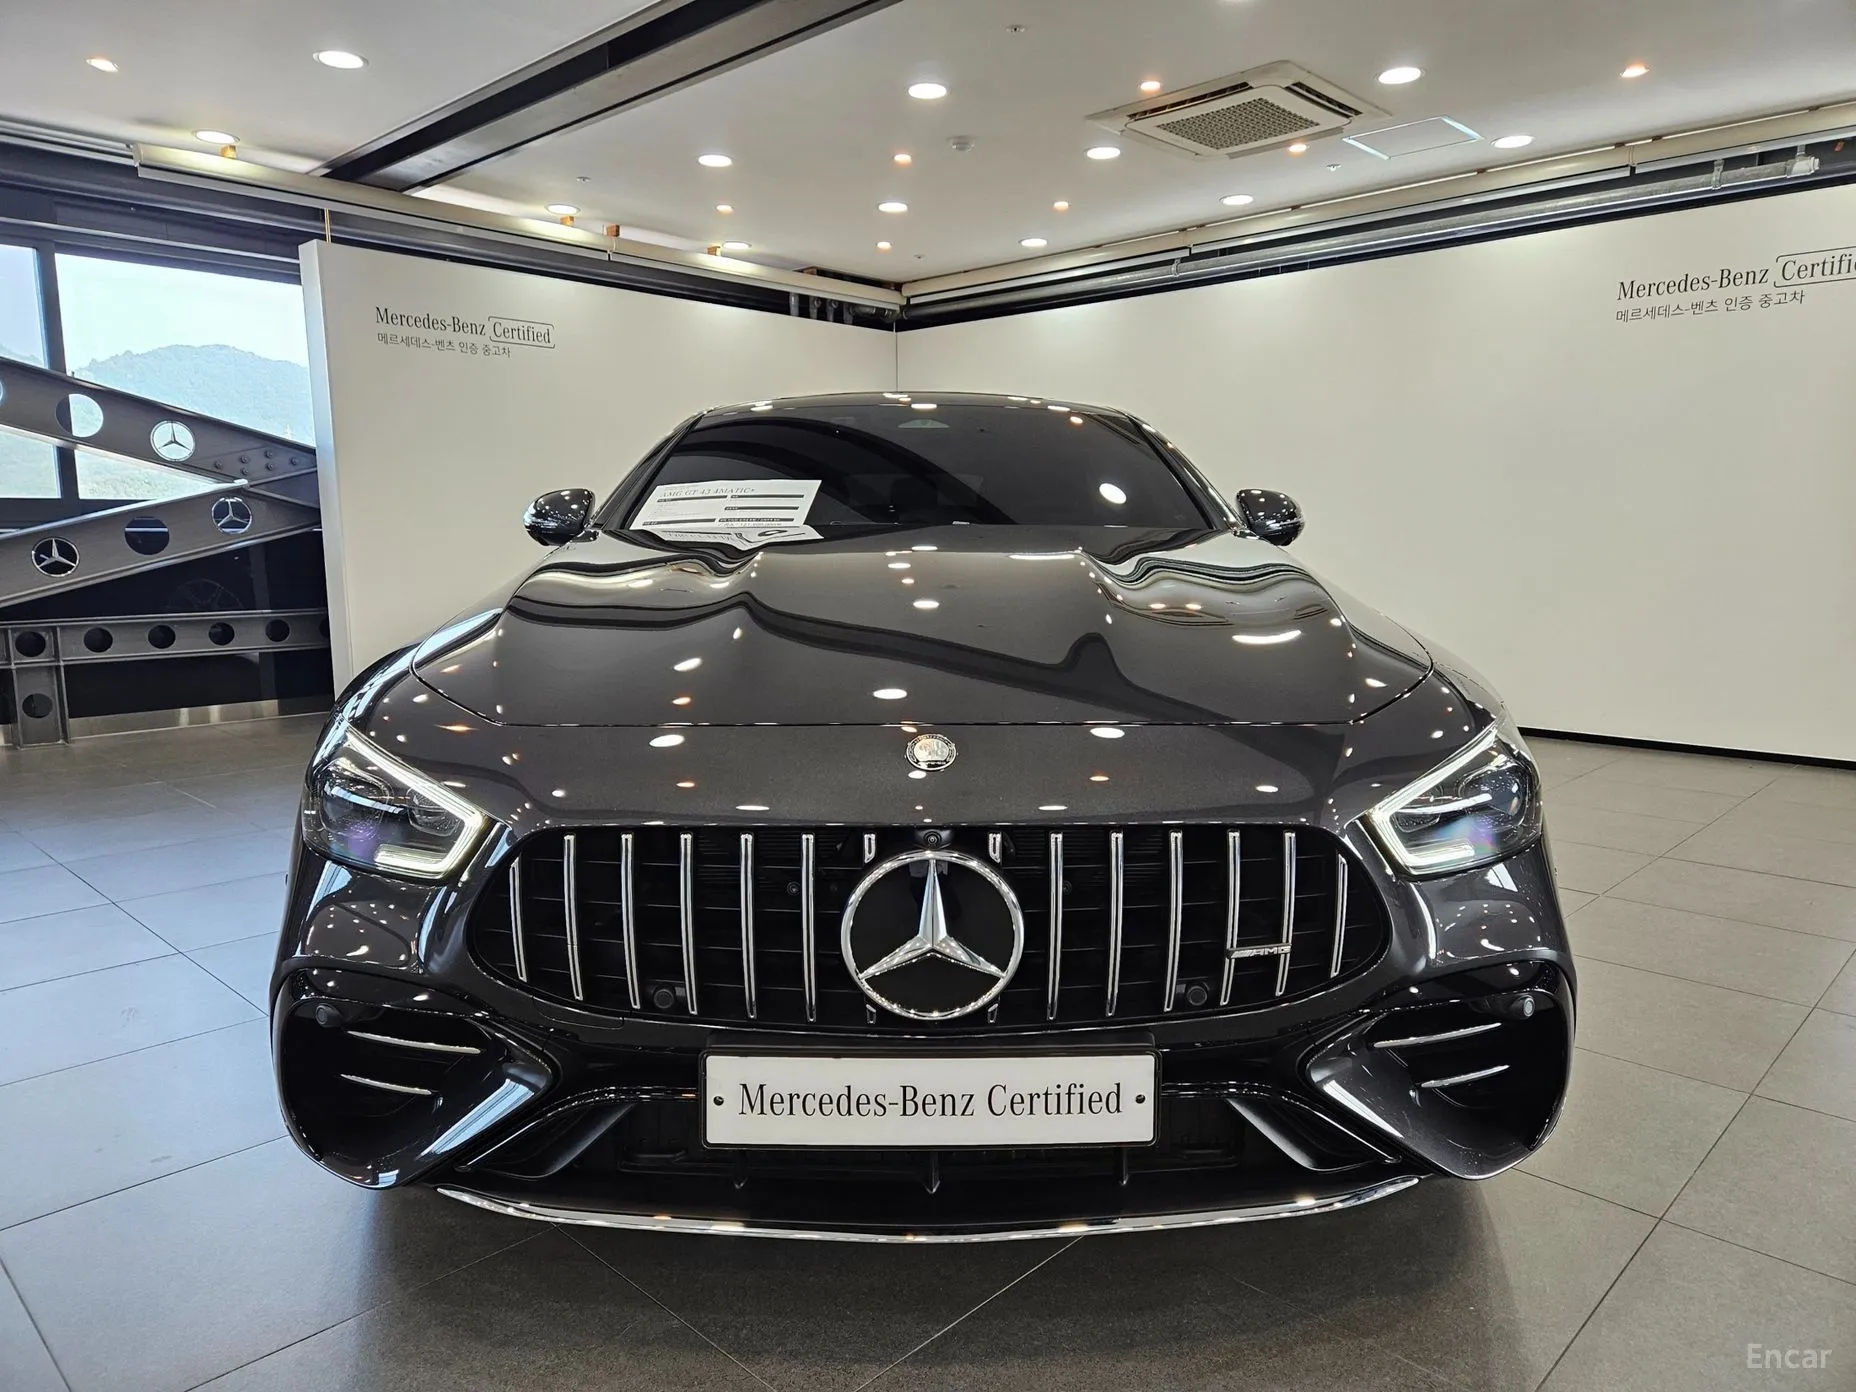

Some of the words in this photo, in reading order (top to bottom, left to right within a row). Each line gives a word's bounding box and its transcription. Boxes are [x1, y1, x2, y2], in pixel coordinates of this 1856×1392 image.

[1617, 268, 1770, 300] Mercedes-Benz
[1781, 253, 1856, 281] Certifi
[1616, 300, 1719, 323] 메르세데스-벤츠
[1724, 296, 1753, 312] 인증
[1759, 290, 1805, 309] 중고차
[375, 306, 486, 336] Mercedes-Benz
[493, 321, 551, 344] Certified
[377, 332, 456, 351] 메르세데스-벤츠
[459, 341, 479, 355] 인증
[482, 345, 511, 358] 중고차
[738, 1083, 975, 1117] Mercedes-Benz
[987, 1082, 1124, 1116] Certified
